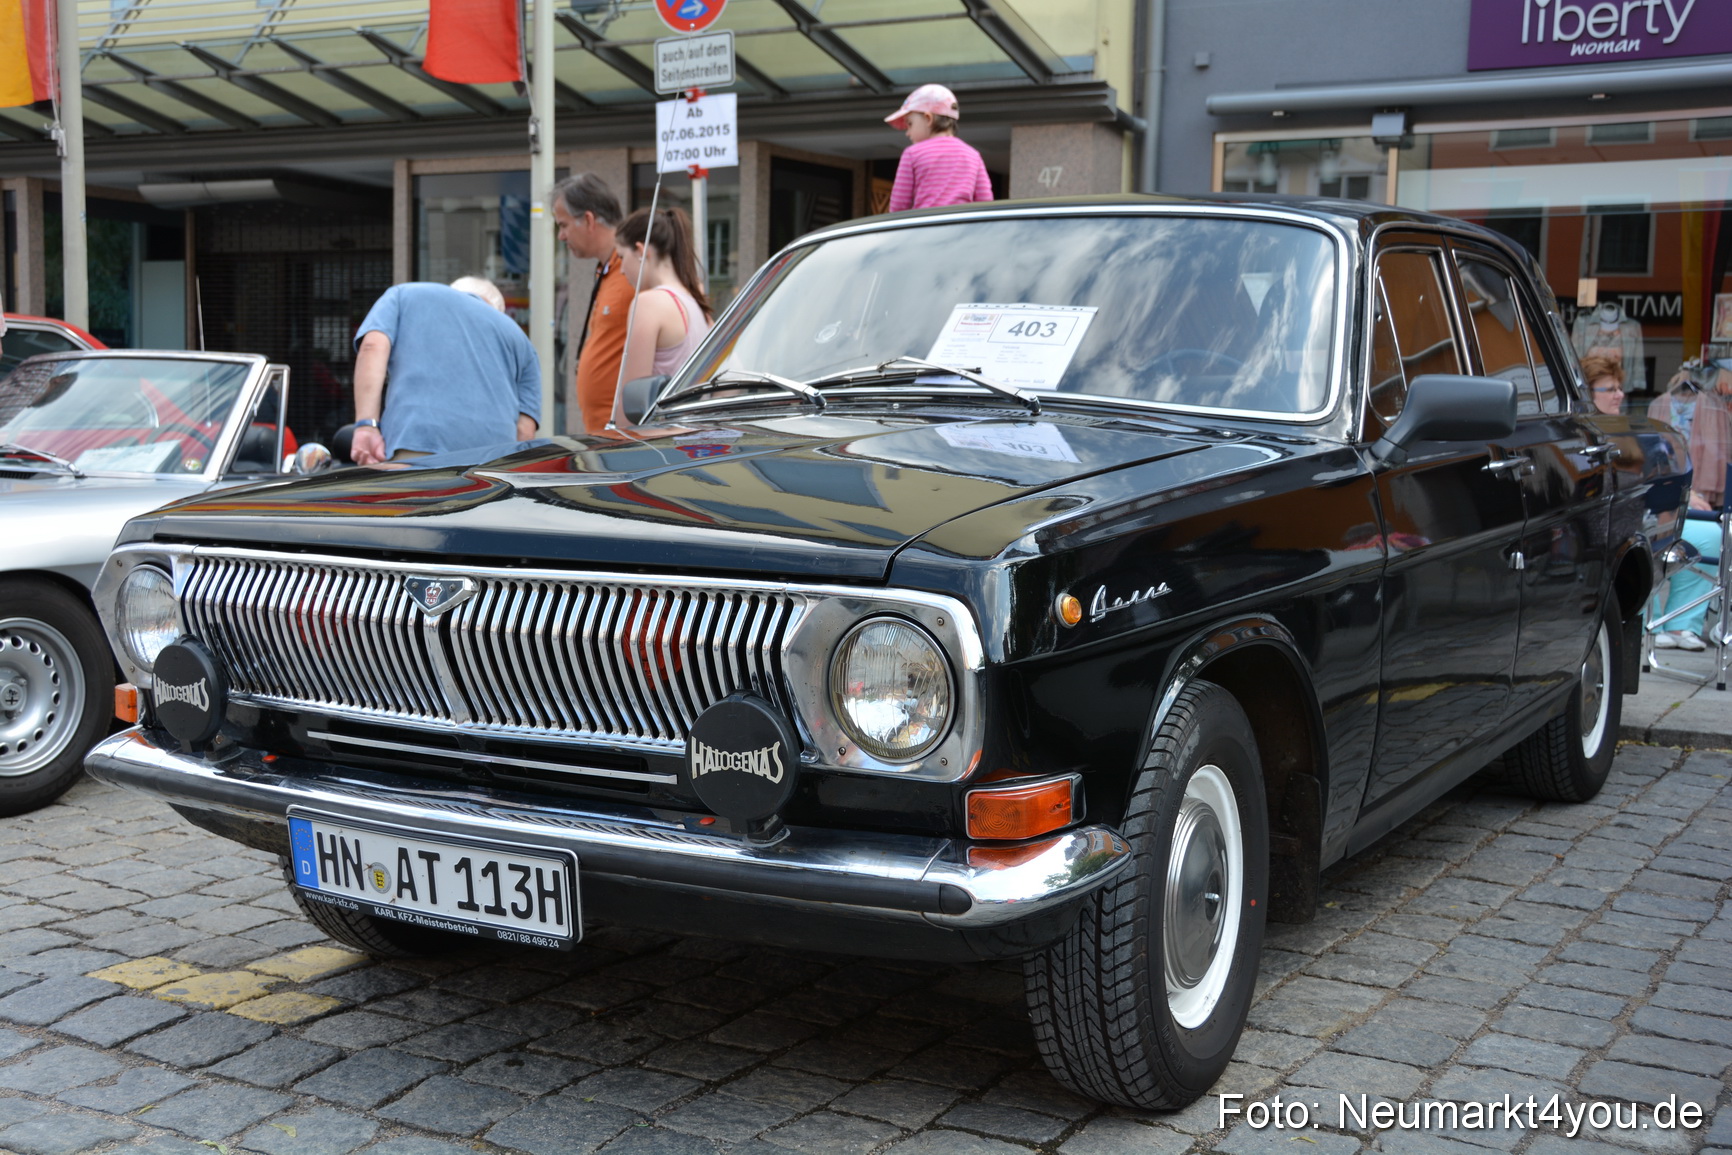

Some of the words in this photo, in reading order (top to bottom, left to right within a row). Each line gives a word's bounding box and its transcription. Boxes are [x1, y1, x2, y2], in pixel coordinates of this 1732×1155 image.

[1521, 0, 1697, 44] liberty
[662, 48, 684, 63] auch
[688, 44, 704, 59] auf
[707, 42, 727, 57] dem
[1570, 38, 1641, 57] woman
[661, 62, 729, 83] Seitenstreifen
[687, 107, 703, 118] Ab
[662, 124, 730, 142] 07.06.2015
[666, 148, 700, 162] 07:00
[704, 146, 727, 158] Uhr
[1038, 166, 1063, 188] 47
[1008, 320, 1057, 338] 403
[153, 672, 210, 712] HALOGENAS
[691, 735, 784, 785] HALOGENAS
[302, 860, 311, 875] D
[316, 831, 364, 891] HN
[396, 846, 441, 905] AT
[454, 856, 563, 926] 113H
[304, 890, 359, 911] www.karl-kfz.de
[374, 906, 396, 919] KARL
[397, 911, 479, 935] KFZ-Meisterbetrieb
